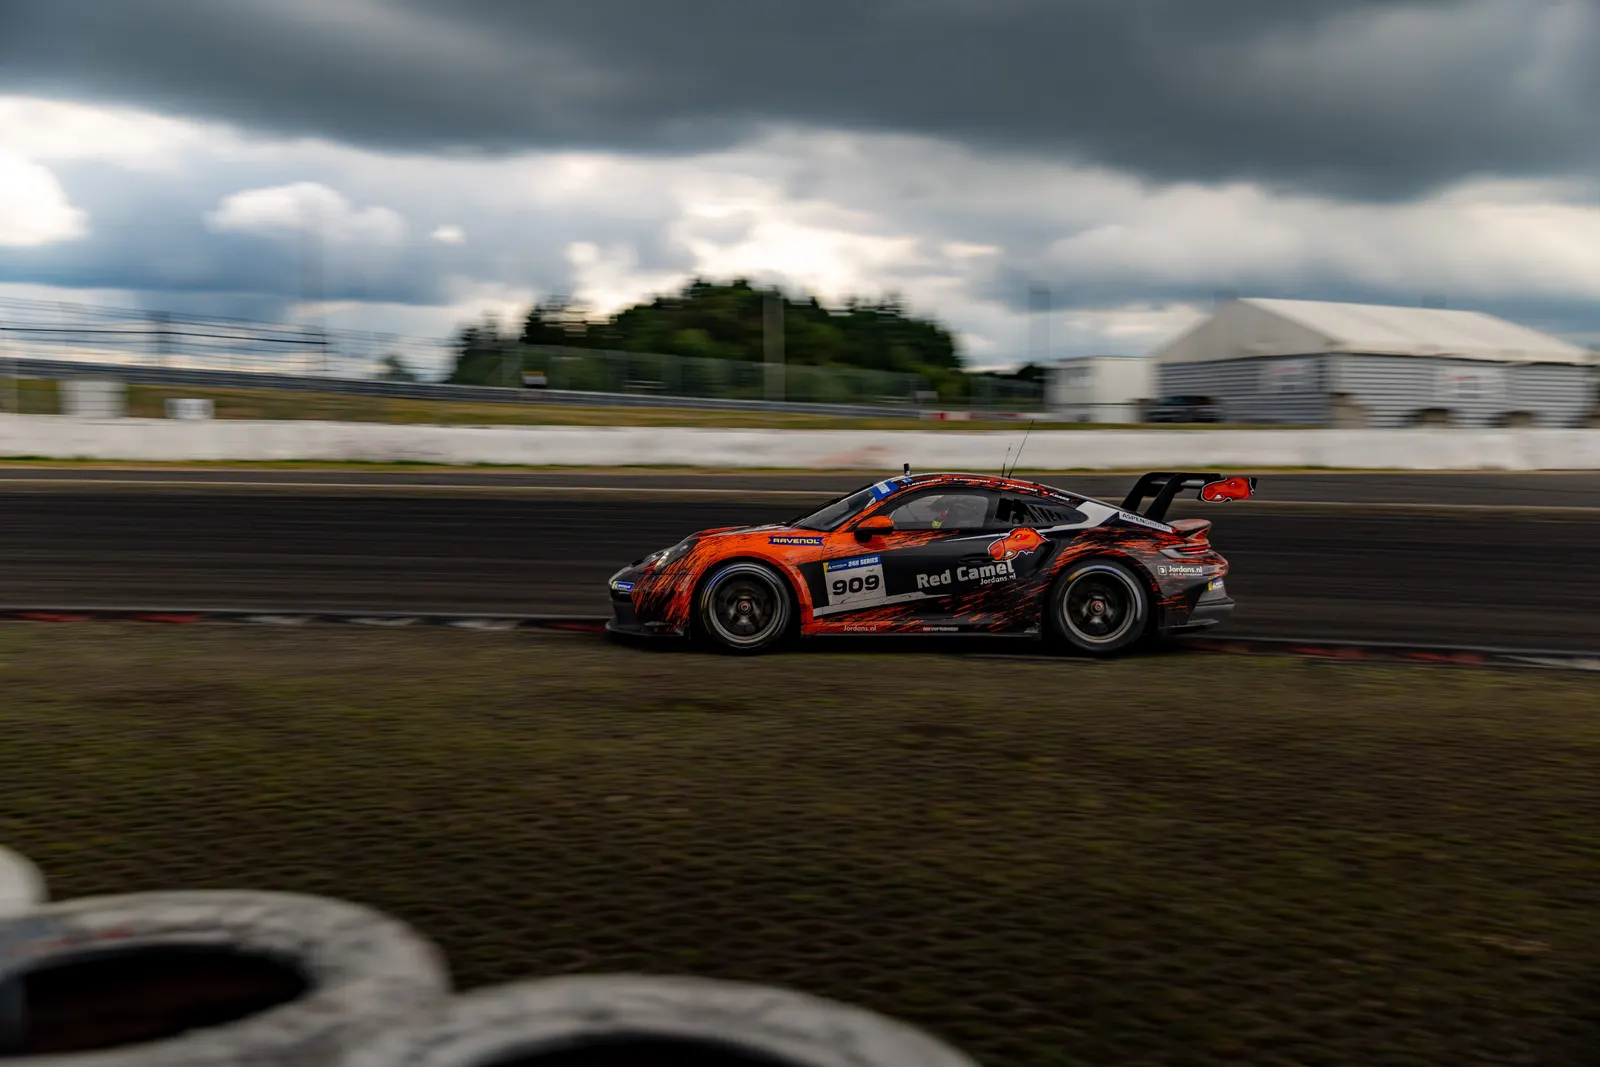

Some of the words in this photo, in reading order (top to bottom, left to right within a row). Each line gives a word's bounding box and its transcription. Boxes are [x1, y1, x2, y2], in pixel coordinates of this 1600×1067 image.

[860, 557, 879, 565] SERIES
[916, 569, 952, 589] Red
[956, 560, 1015, 582] Camel
[1168, 565, 1203, 573] Jordans.nl
[832, 575, 880, 595] 909
[980, 573, 1017, 585] Jordans.nl
